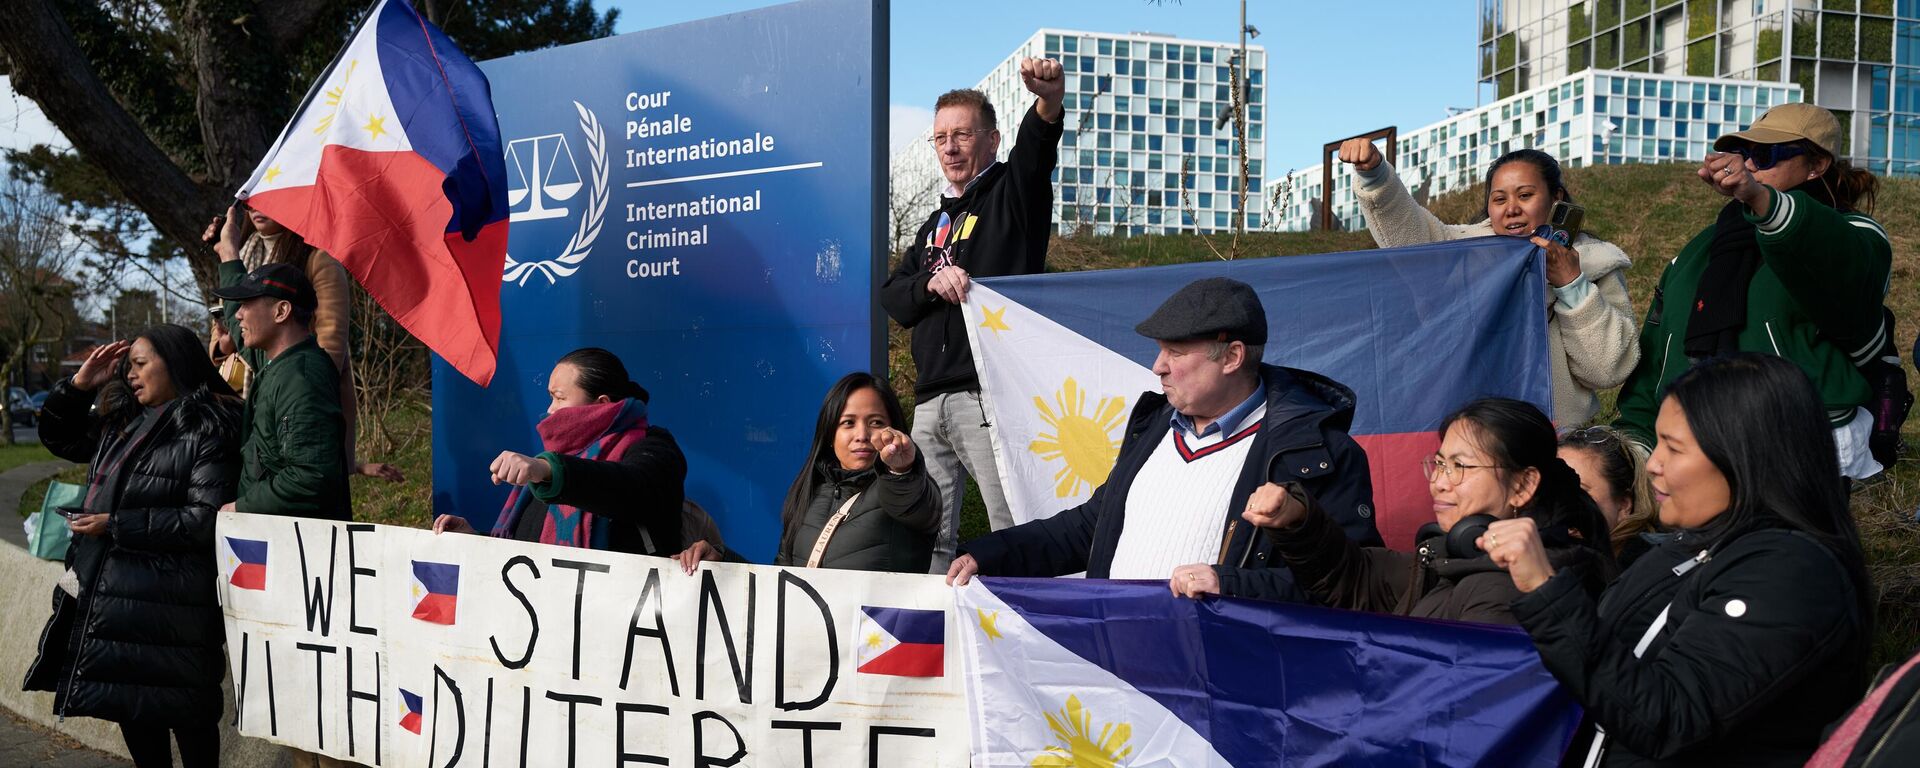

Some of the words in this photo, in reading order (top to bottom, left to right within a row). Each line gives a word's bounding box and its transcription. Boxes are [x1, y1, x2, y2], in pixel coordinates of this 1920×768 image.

[625, 91, 671, 111] Cour
[626, 114, 692, 139] Pénale
[626, 132, 774, 168] Internationale
[626, 190, 761, 222] International
[626, 225, 708, 250] Criminal
[626, 257, 680, 278] Court
[294, 522, 378, 637] WE
[489, 555, 839, 711] STAND
[232, 632, 381, 766] WITH
